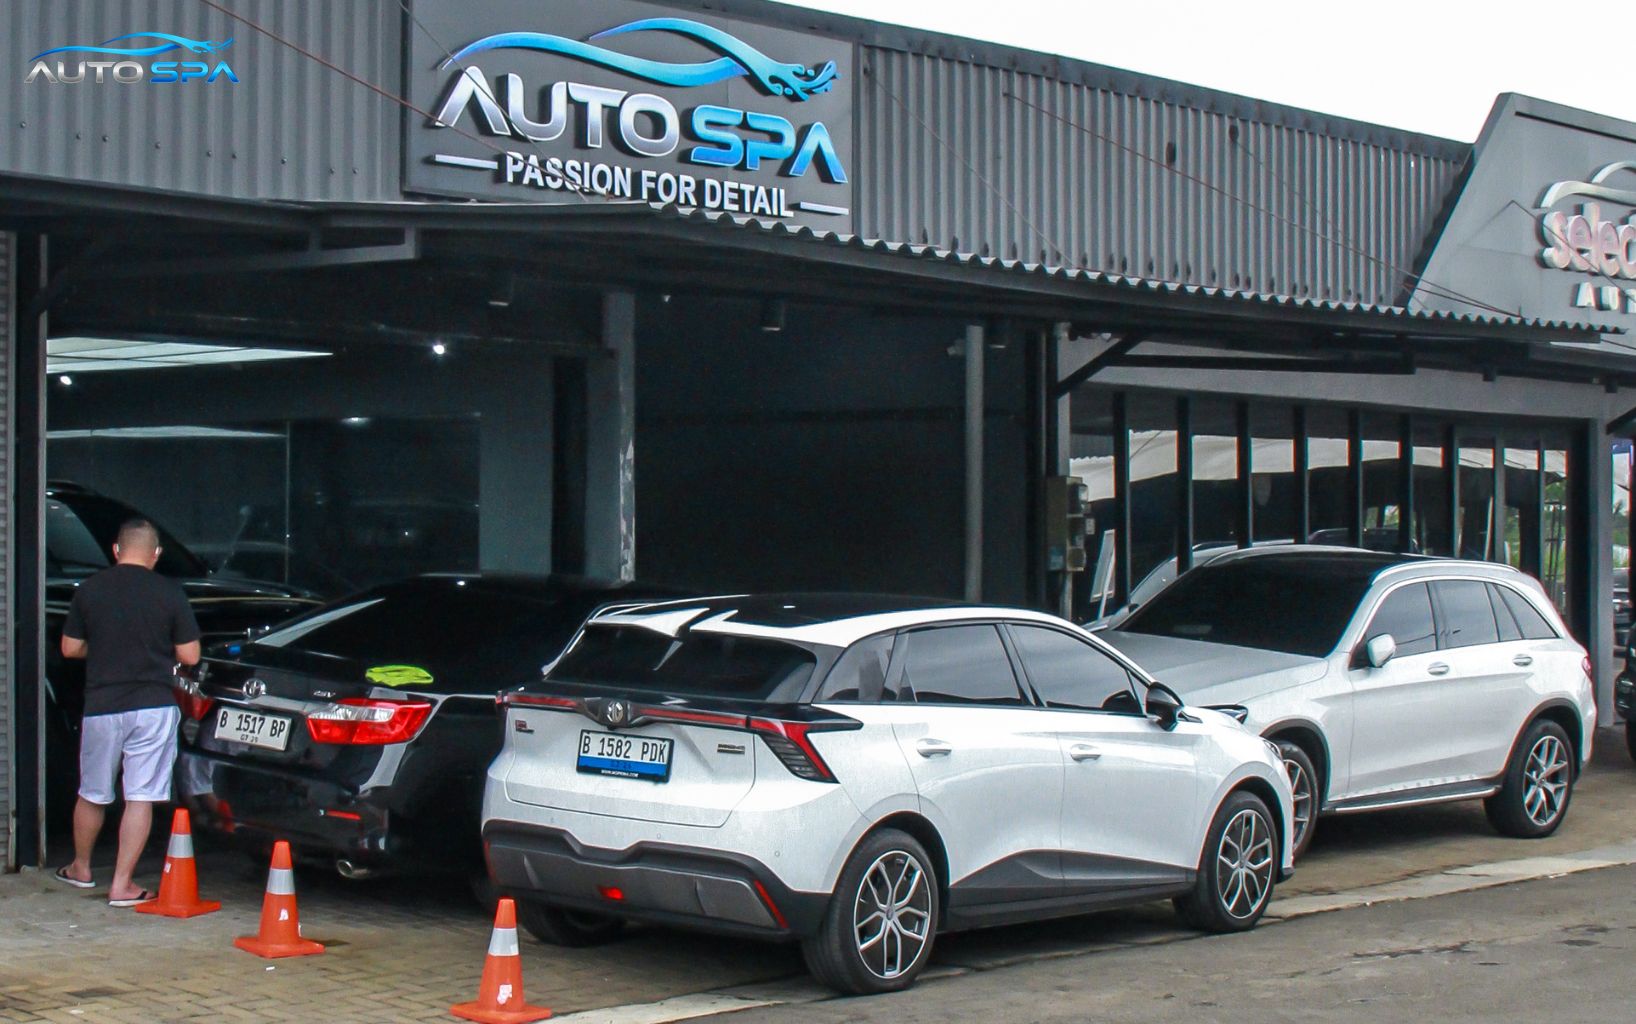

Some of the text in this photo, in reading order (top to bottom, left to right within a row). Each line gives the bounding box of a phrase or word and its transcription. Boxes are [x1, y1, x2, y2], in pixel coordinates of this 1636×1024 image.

[434, 66, 849, 184] AUTO SPA
[506, 151, 795, 218] PASSION FOR DETAIL
[220, 710, 286, 738] B 1517 BP
[582, 735, 667, 763] B 1582 PDK
